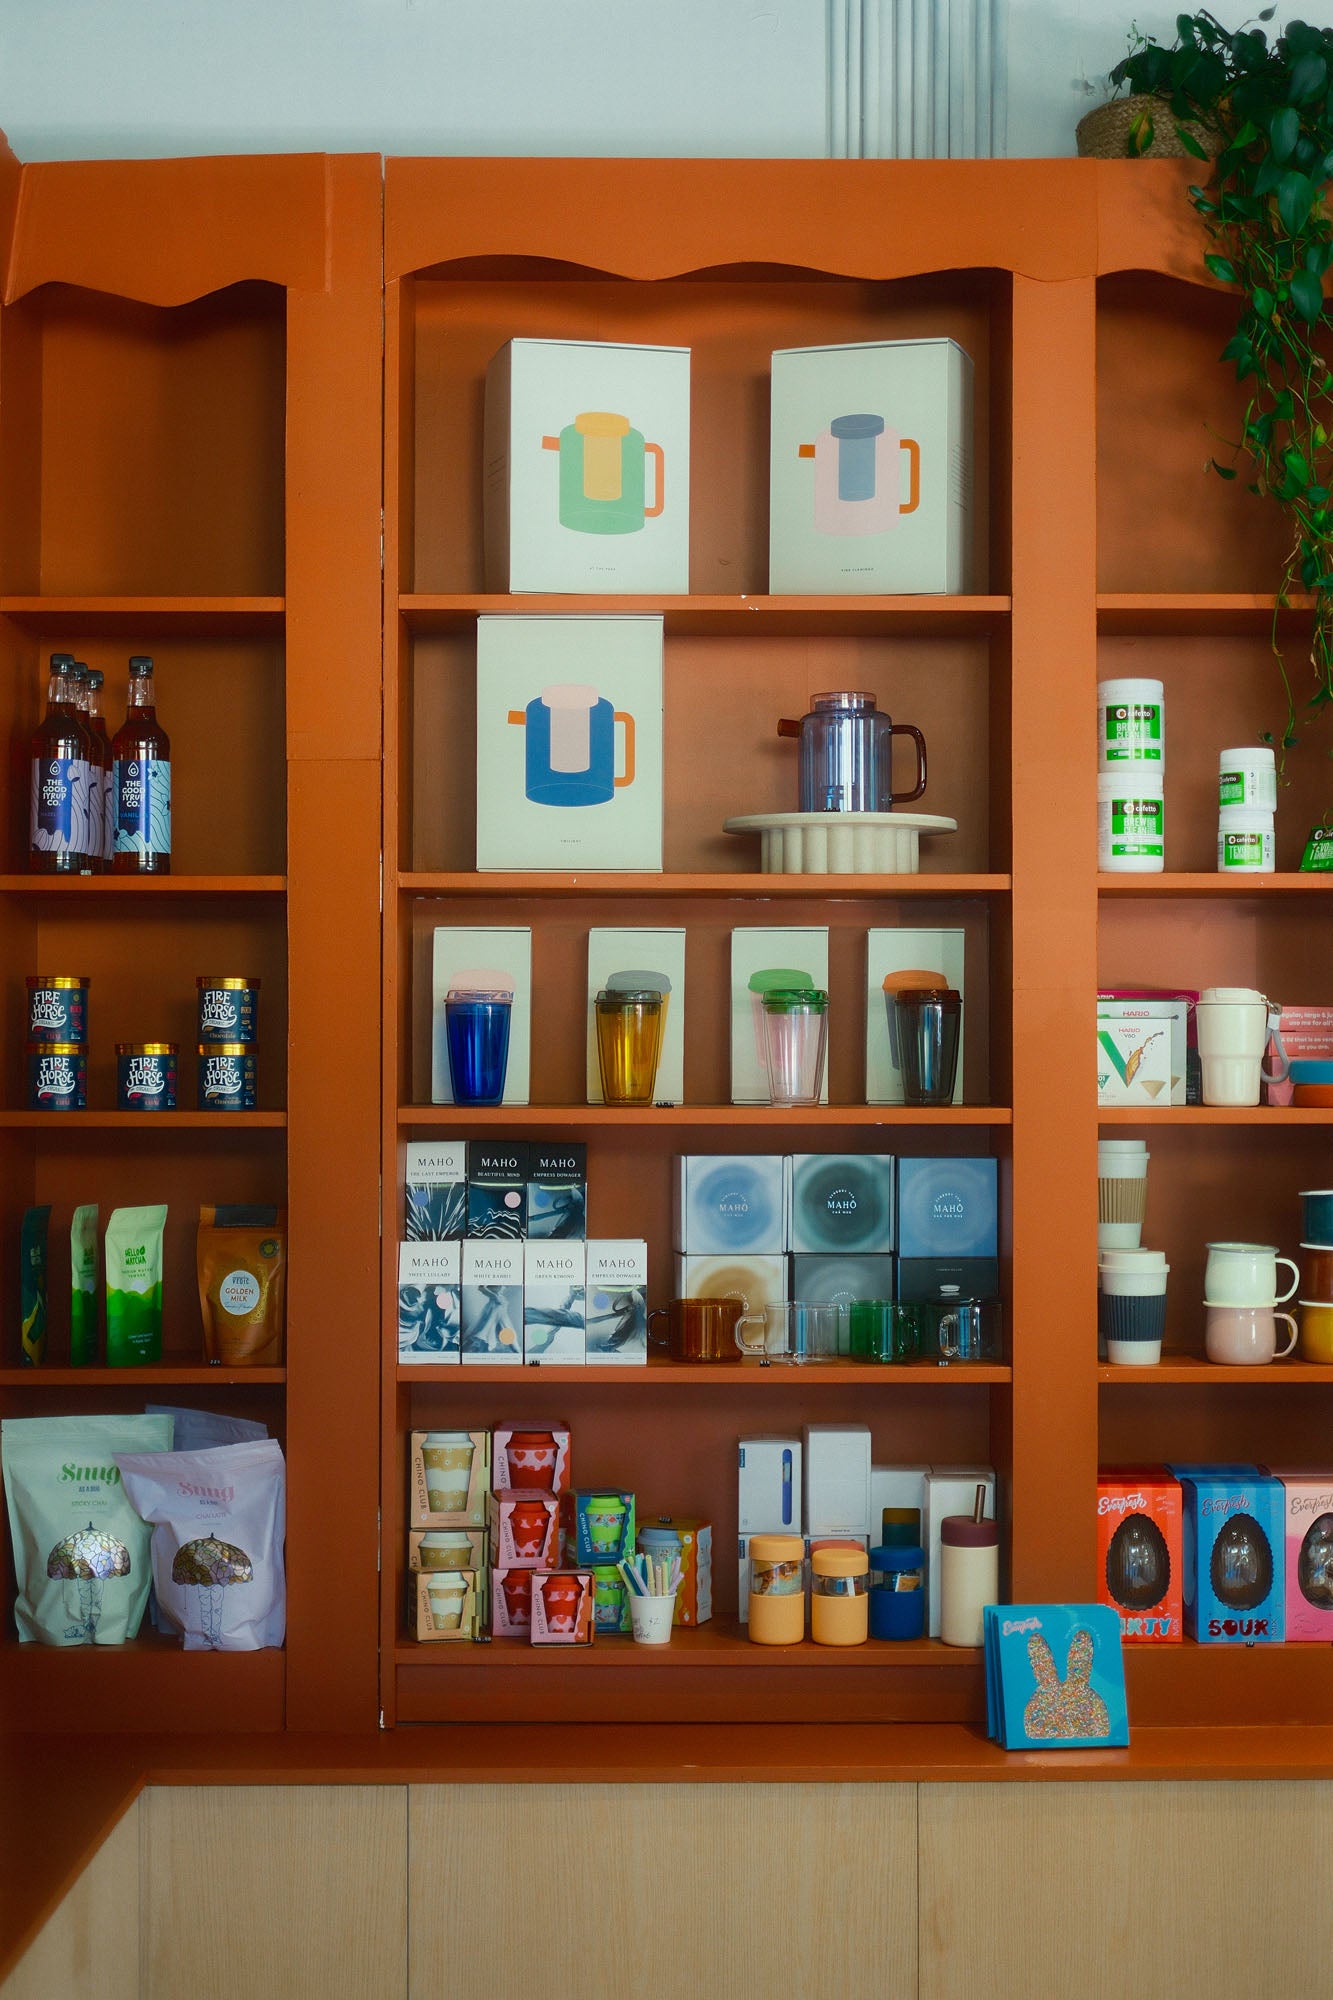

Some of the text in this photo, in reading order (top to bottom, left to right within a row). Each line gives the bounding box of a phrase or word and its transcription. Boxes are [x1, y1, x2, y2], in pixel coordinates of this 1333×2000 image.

[43, 792, 67, 801] SYRUP
[122, 794, 144, 802] SYRUP
[1135, 804, 1157, 812] cafetto
[1123, 817, 1147, 826] BREW
[33, 990, 60, 1005] FIRE
[204, 990, 231, 1005] FIRE
[40, 1057, 69, 1071] FIRE
[129, 1057, 158, 1071] FIRE
[207, 1057, 235, 1071] FIRE
[481, 1157, 518, 1168] MAHÔ
[540, 1158, 576, 1168] MAHÔ
[125, 1248, 140, 1257] HELLO
[126, 1256, 146, 1265] MATCHA
[225, 1287, 254, 1295] GOLDEN
[57, 1462, 120, 1486] Snug
[415, 1457, 424, 1486] CHINO
[498, 1456, 507, 1484] CHINO
[177, 1481, 234, 1504] Snug
[1097, 1493, 1148, 1515] Everfresh
[1202, 1494, 1250, 1516] Everfresh
[579, 1512, 589, 1535] CHINO
[502, 1521, 511, 1543] CHINO
[420, 1590, 429, 1613] CHINO
[495, 1588, 504, 1610] CHINO
[534, 1593, 542, 1617] CHINO
